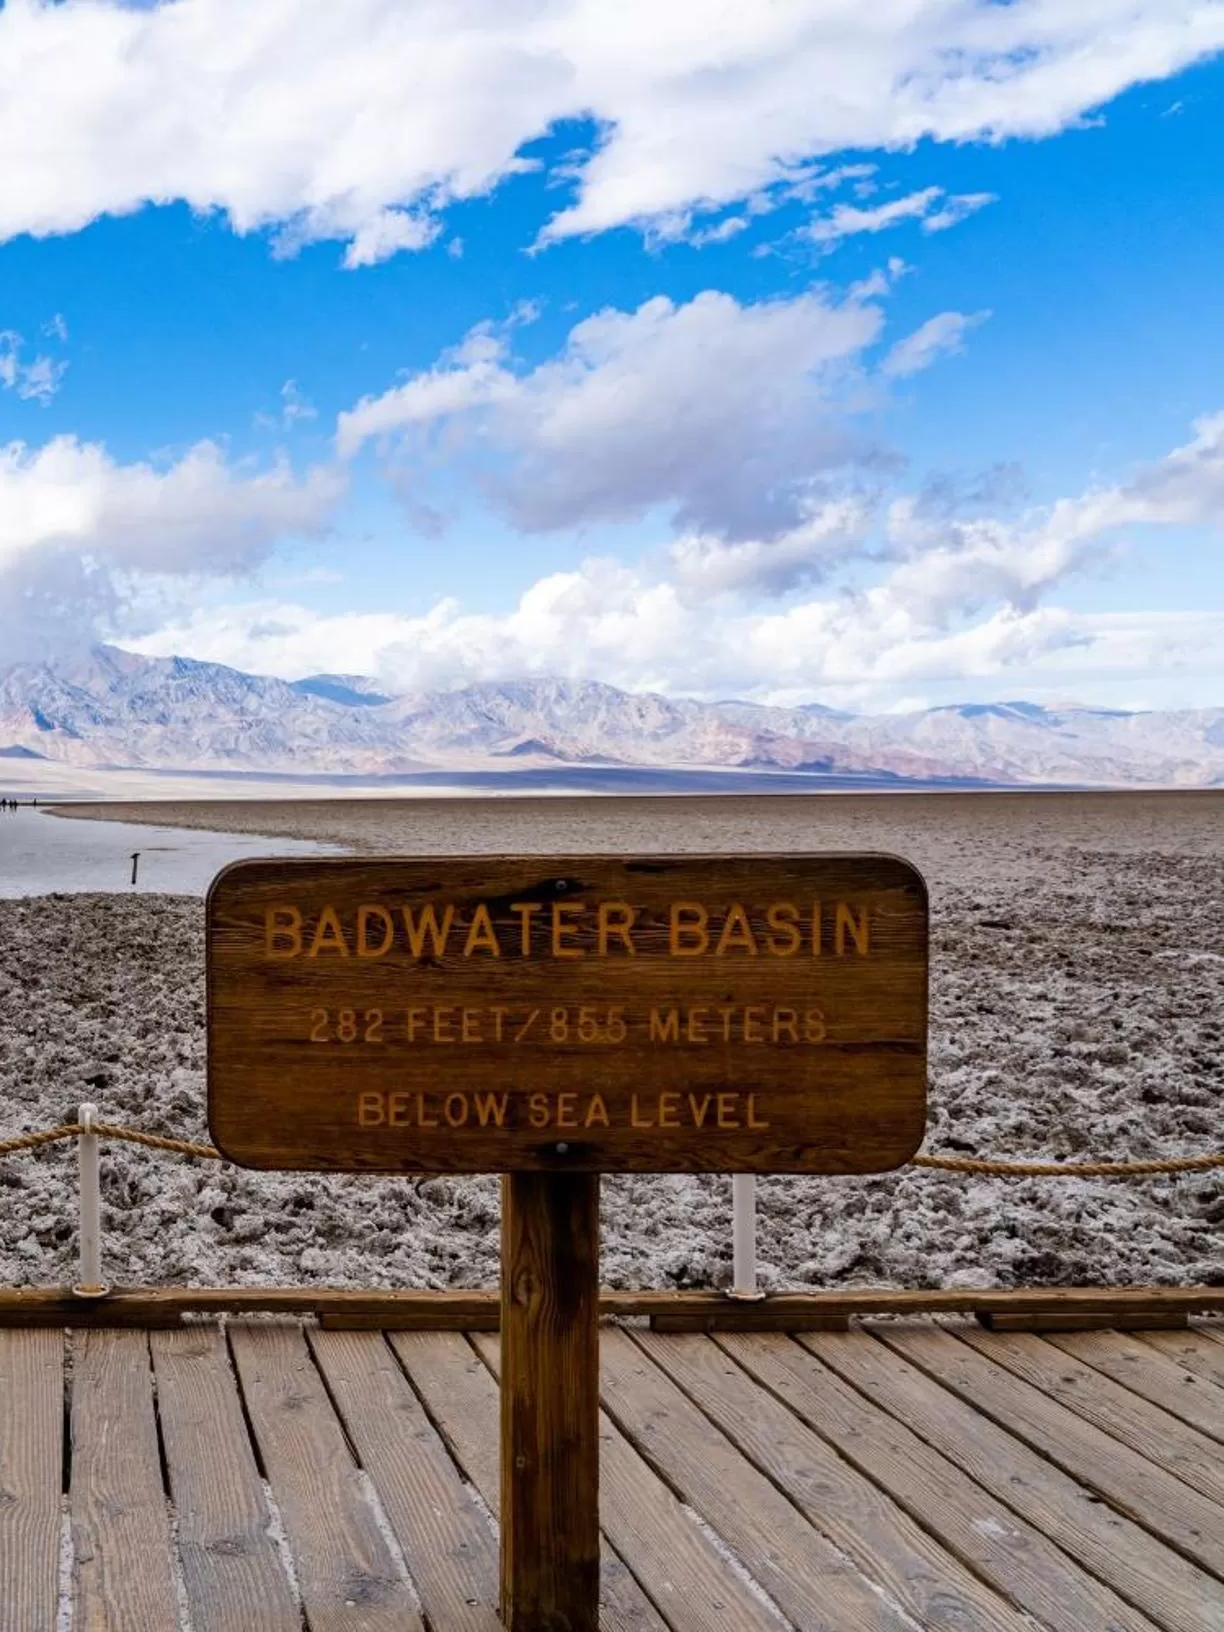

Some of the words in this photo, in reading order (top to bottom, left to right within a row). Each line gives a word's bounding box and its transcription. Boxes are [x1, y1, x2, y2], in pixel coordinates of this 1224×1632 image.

[263, 900, 636, 958] BADWATER
[668, 899, 870, 957] BASIN
[309, 1007, 385, 1043] 282
[649, 1006, 828, 1043] METERS
[357, 1091, 509, 1128] BELOW
[528, 1091, 611, 1128] SEA
[630, 1091, 770, 1128] LEVEL
